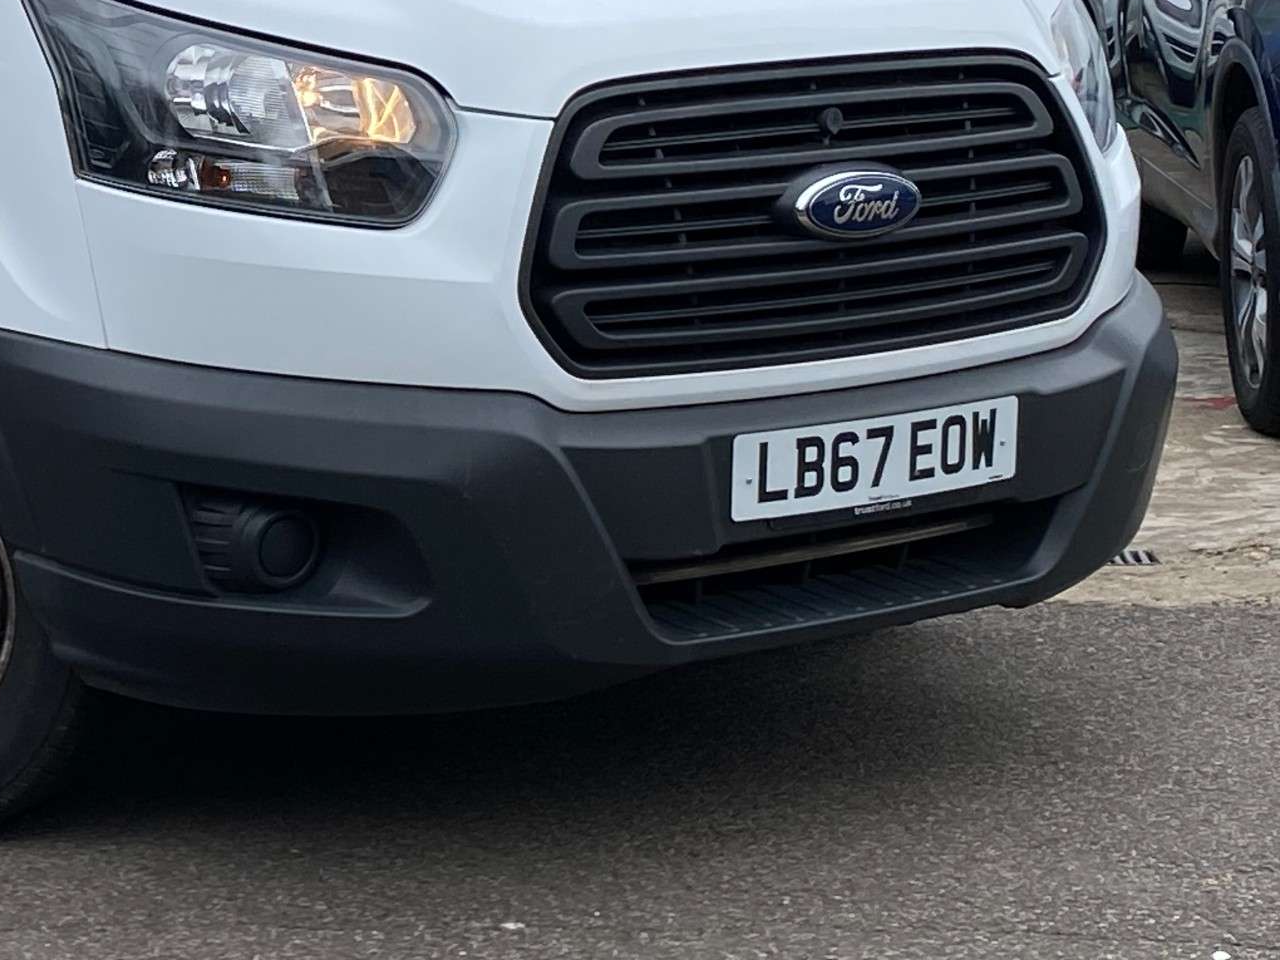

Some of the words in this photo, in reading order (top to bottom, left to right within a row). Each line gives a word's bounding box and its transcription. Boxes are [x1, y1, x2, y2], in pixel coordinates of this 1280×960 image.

[833, 184, 900, 225] Ford
[757, 425, 895, 504] LB67
[908, 408, 998, 482] EOW
